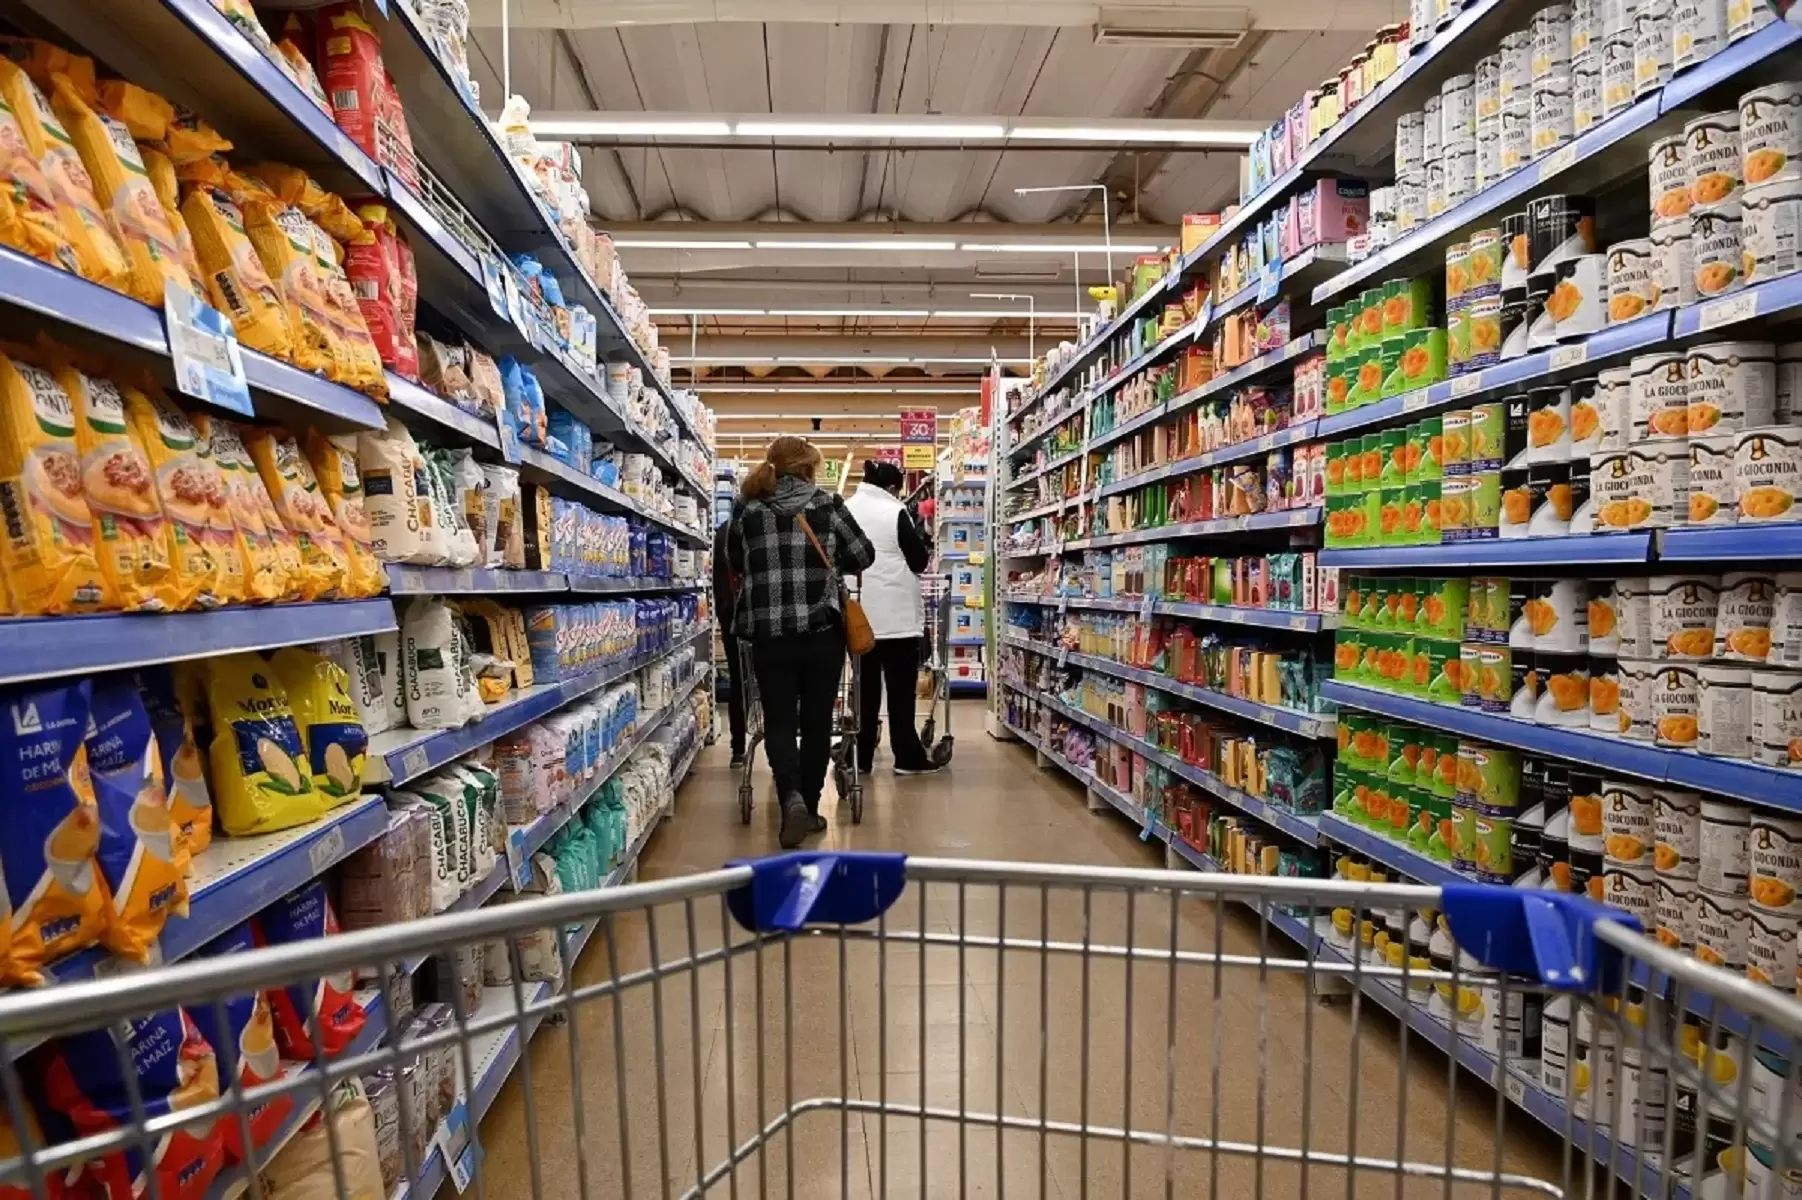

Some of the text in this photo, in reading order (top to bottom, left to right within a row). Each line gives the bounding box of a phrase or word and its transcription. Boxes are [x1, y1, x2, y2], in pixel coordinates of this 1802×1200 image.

[1744, 462, 1798, 477] GIOCONDA
[407, 637, 422, 701] CHACABUCO
[456, 799, 469, 883] CHACABUCO
